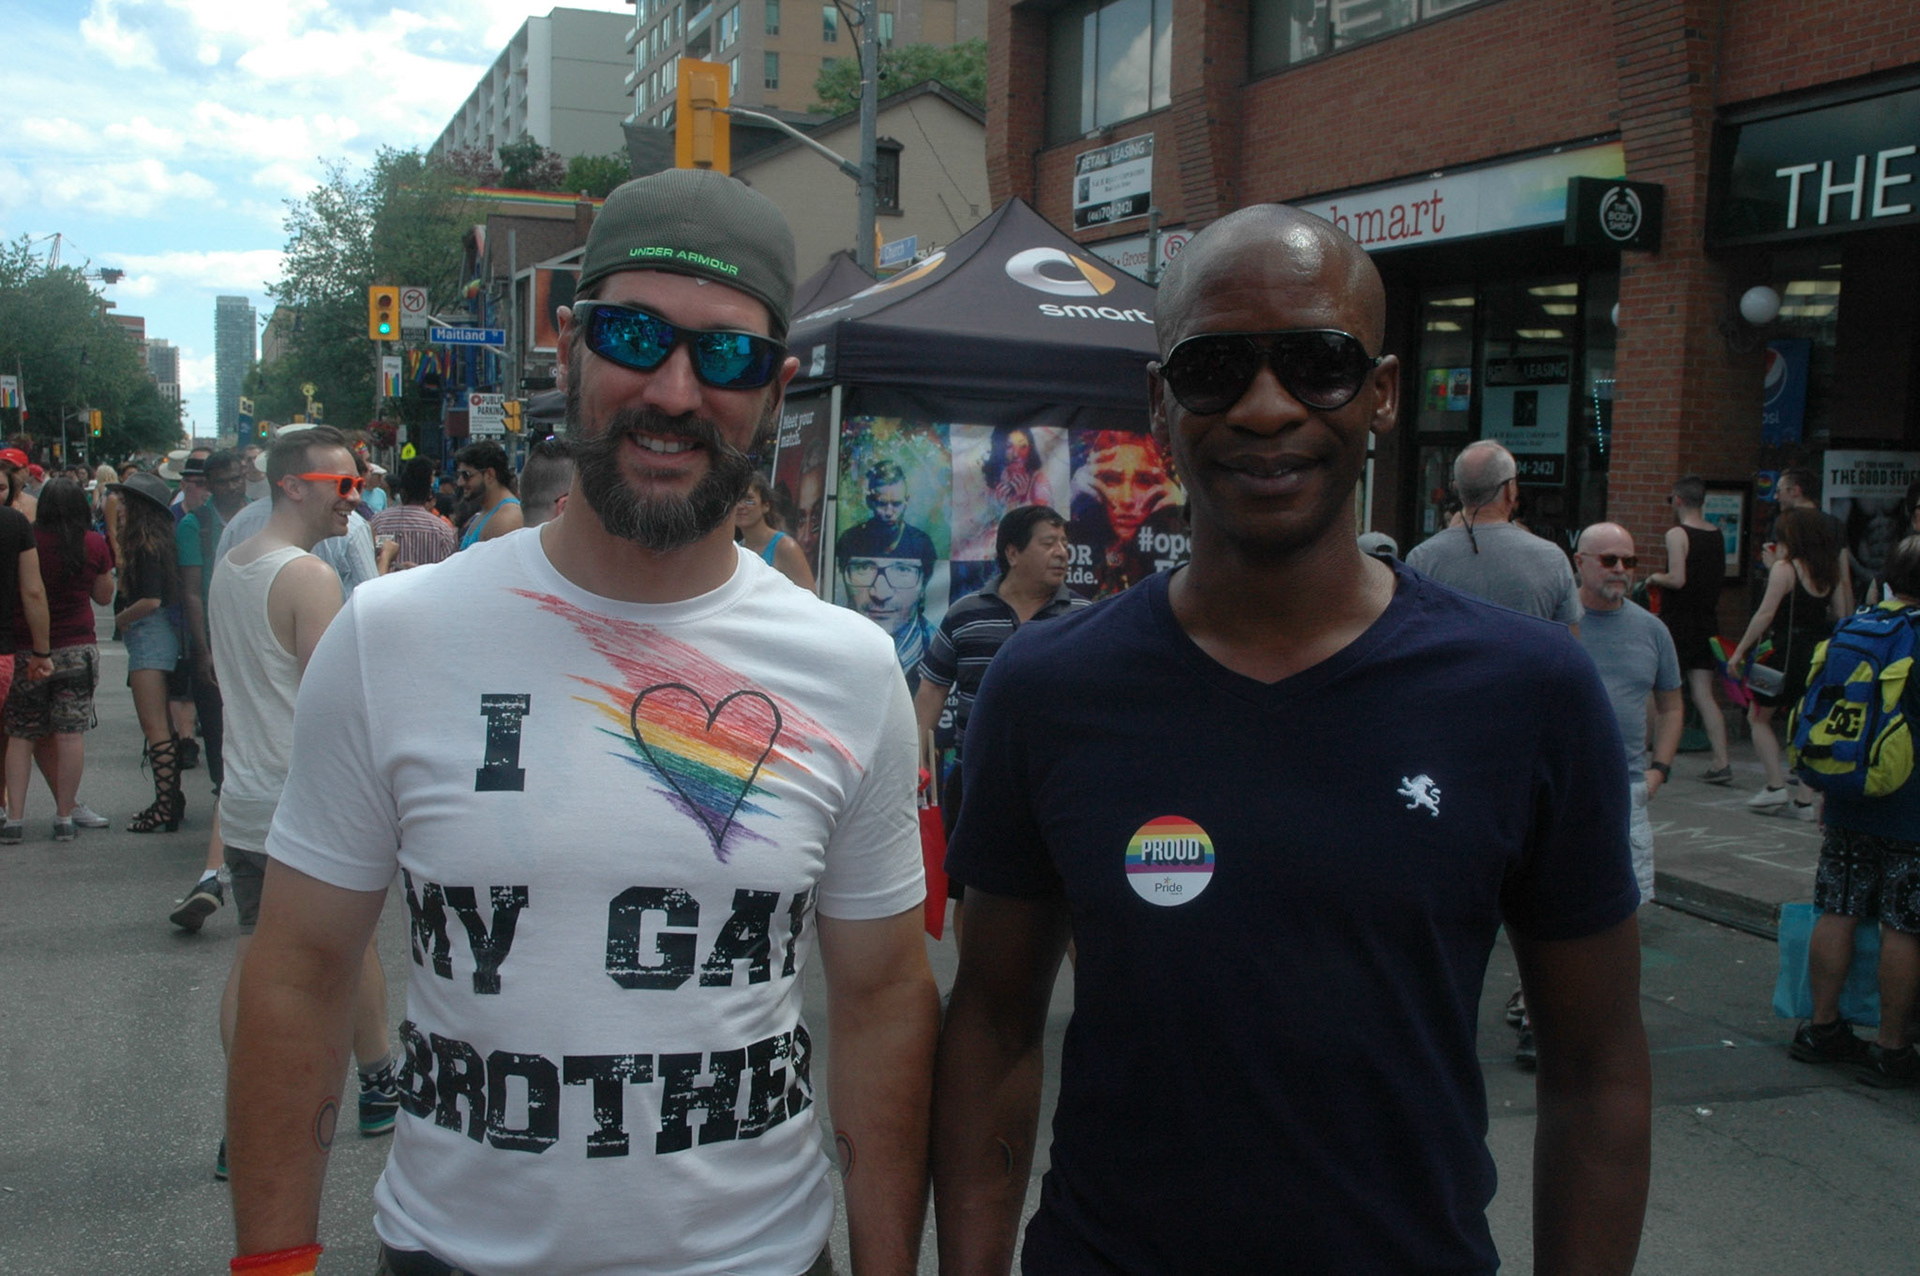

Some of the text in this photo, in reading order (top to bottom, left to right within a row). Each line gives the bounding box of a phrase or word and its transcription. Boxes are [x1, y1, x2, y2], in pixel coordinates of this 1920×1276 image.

[1111, 142, 1145, 162] LEASING
[1776, 145, 1917, 229] THE
[1607, 210, 1634, 221] BODY
[1608, 220, 1633, 231] SHOP
[629, 247, 739, 276] UNDER ARMOUR
[1038, 303, 1155, 325] smart
[436, 329, 486, 341] Maitland
[1524, 362, 1567, 379] LEASING
[482, 395, 504, 405] PUBLIC
[477, 406, 504, 416] PARKING
[1831, 469, 1920, 486] THE GOOD STUF
[475, 693, 531, 792] I
[1141, 838, 1202, 862] PROUD
[1154, 882, 1183, 893] Pride
[401, 867, 529, 994] MY
[398, 1020, 814, 1158] BROTHER
